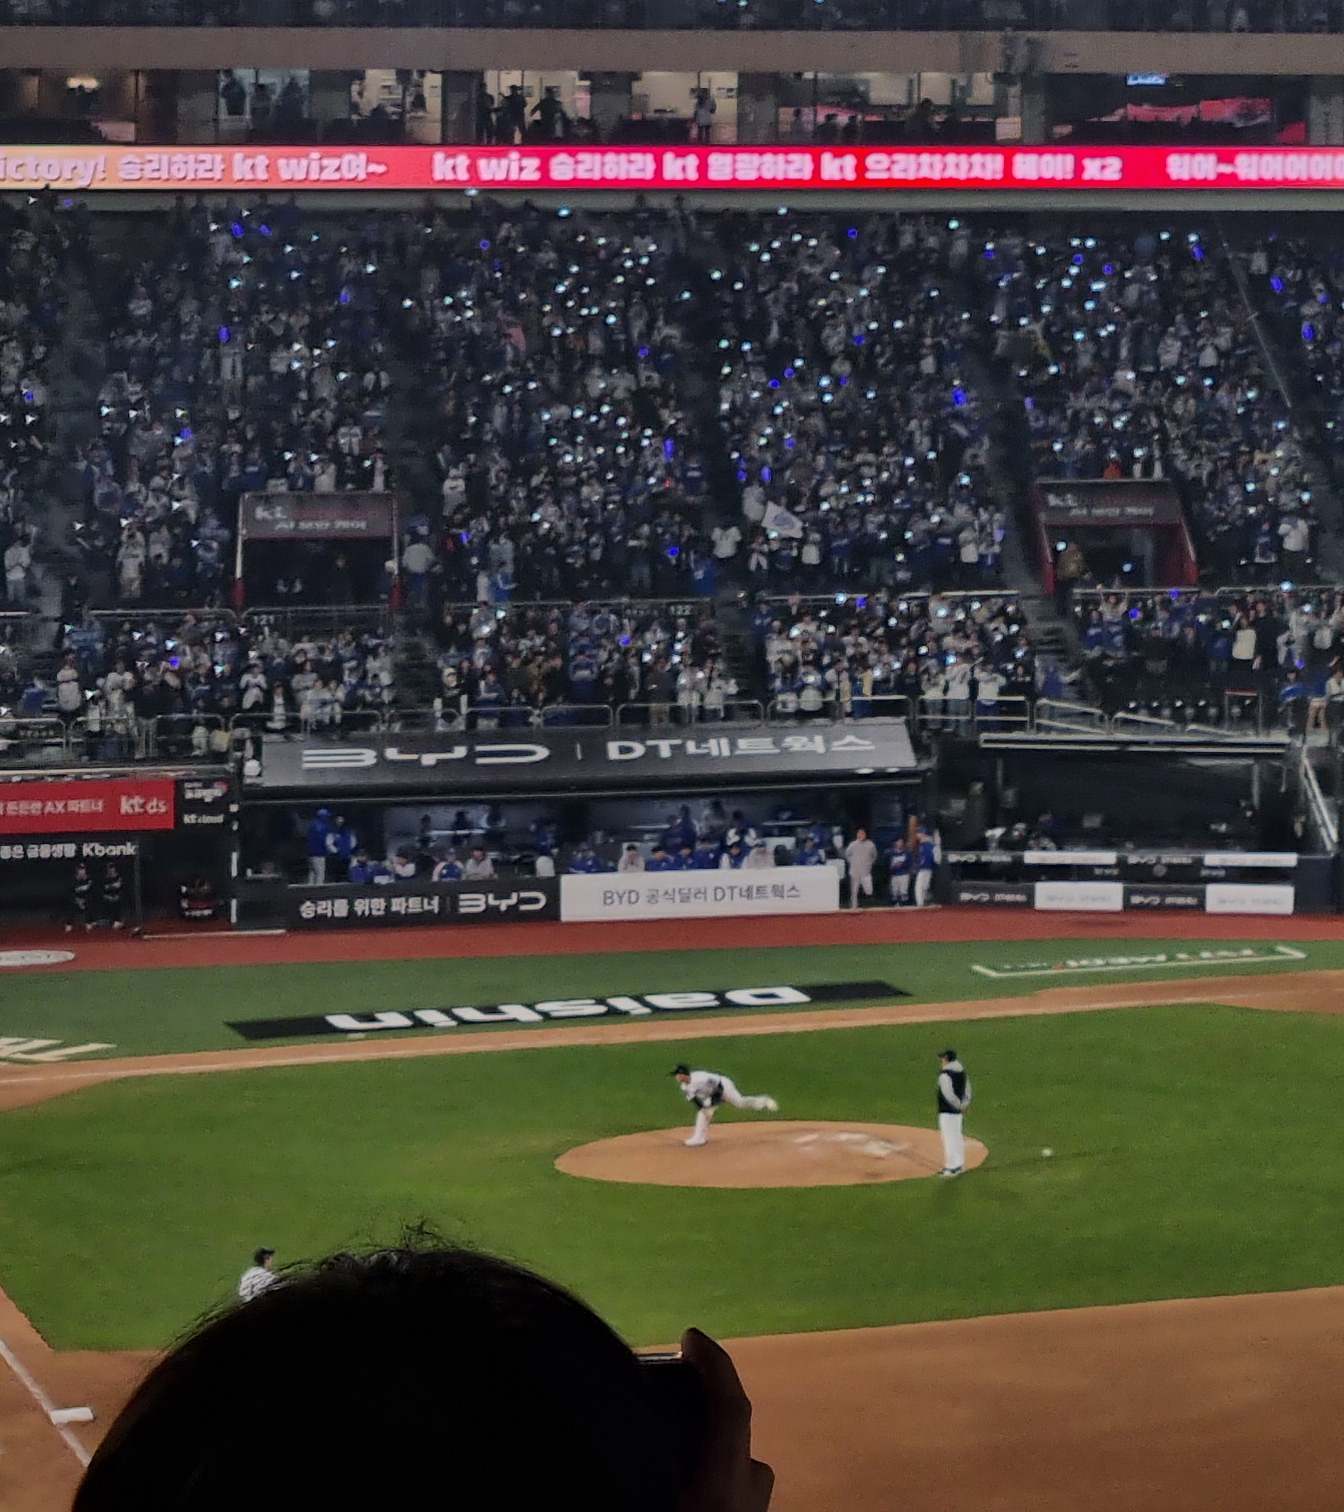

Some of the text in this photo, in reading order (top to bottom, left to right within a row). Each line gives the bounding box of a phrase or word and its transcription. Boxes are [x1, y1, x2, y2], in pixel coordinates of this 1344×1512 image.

[118, 152, 226, 181] 승리하라
[233, 152, 269, 181] kt
[432, 152, 471, 181] kt
[476, 150, 541, 181] wiz
[548, 152, 655, 181] 승리하라
[662, 152, 699, 181] kt
[820, 152, 857, 181] kt
[1081, 156, 1123, 181] x2
[302, 734, 876, 768] BYD DT네트웍스
[120, 795, 145, 815] kt
[146, 797, 167, 814] ds
[301, 891, 547, 919] 승리를 위한 파트너 BYD
[602, 884, 801, 906] BYD 공식딜러 DT네트웍스
[324, 986, 811, 1032] Daishin
